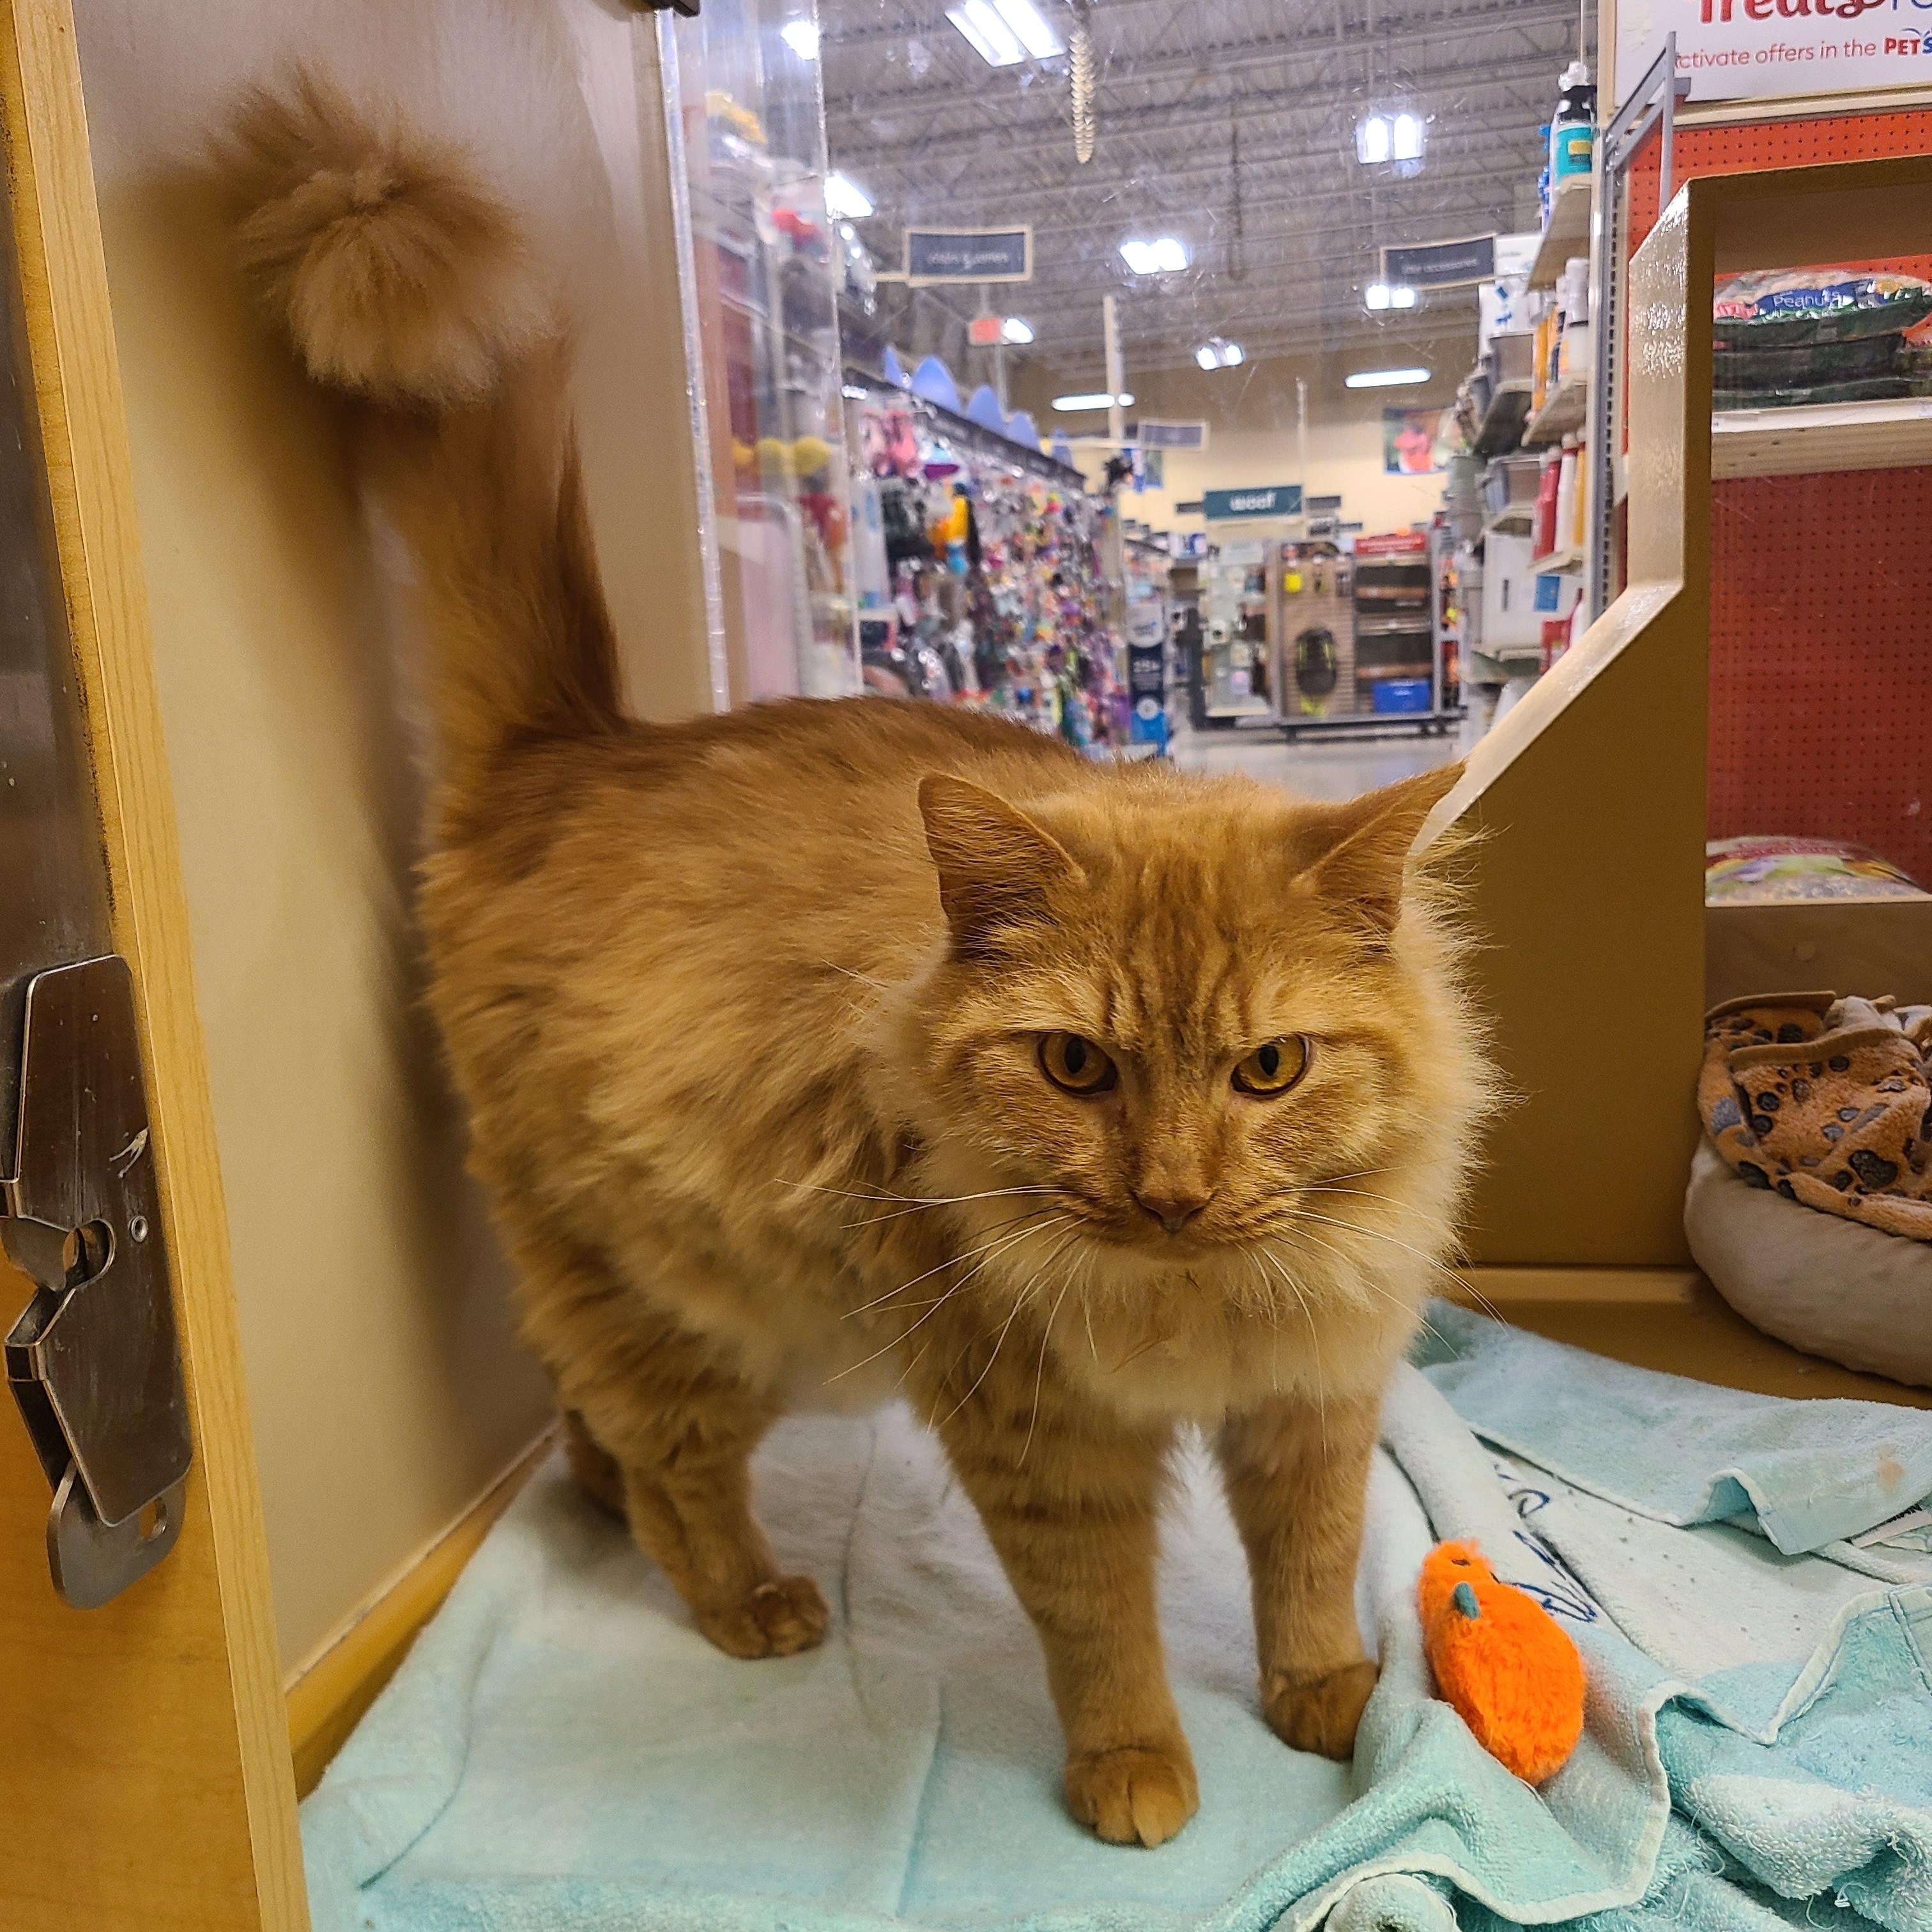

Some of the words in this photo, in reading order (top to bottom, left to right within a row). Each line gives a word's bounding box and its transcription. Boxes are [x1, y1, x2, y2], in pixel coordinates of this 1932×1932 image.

[1675, 48, 1750, 69] ctivate
[1755, 43, 1814, 64] offers
[1821, 41, 1837, 59] in
[1844, 39, 1876, 57] the
